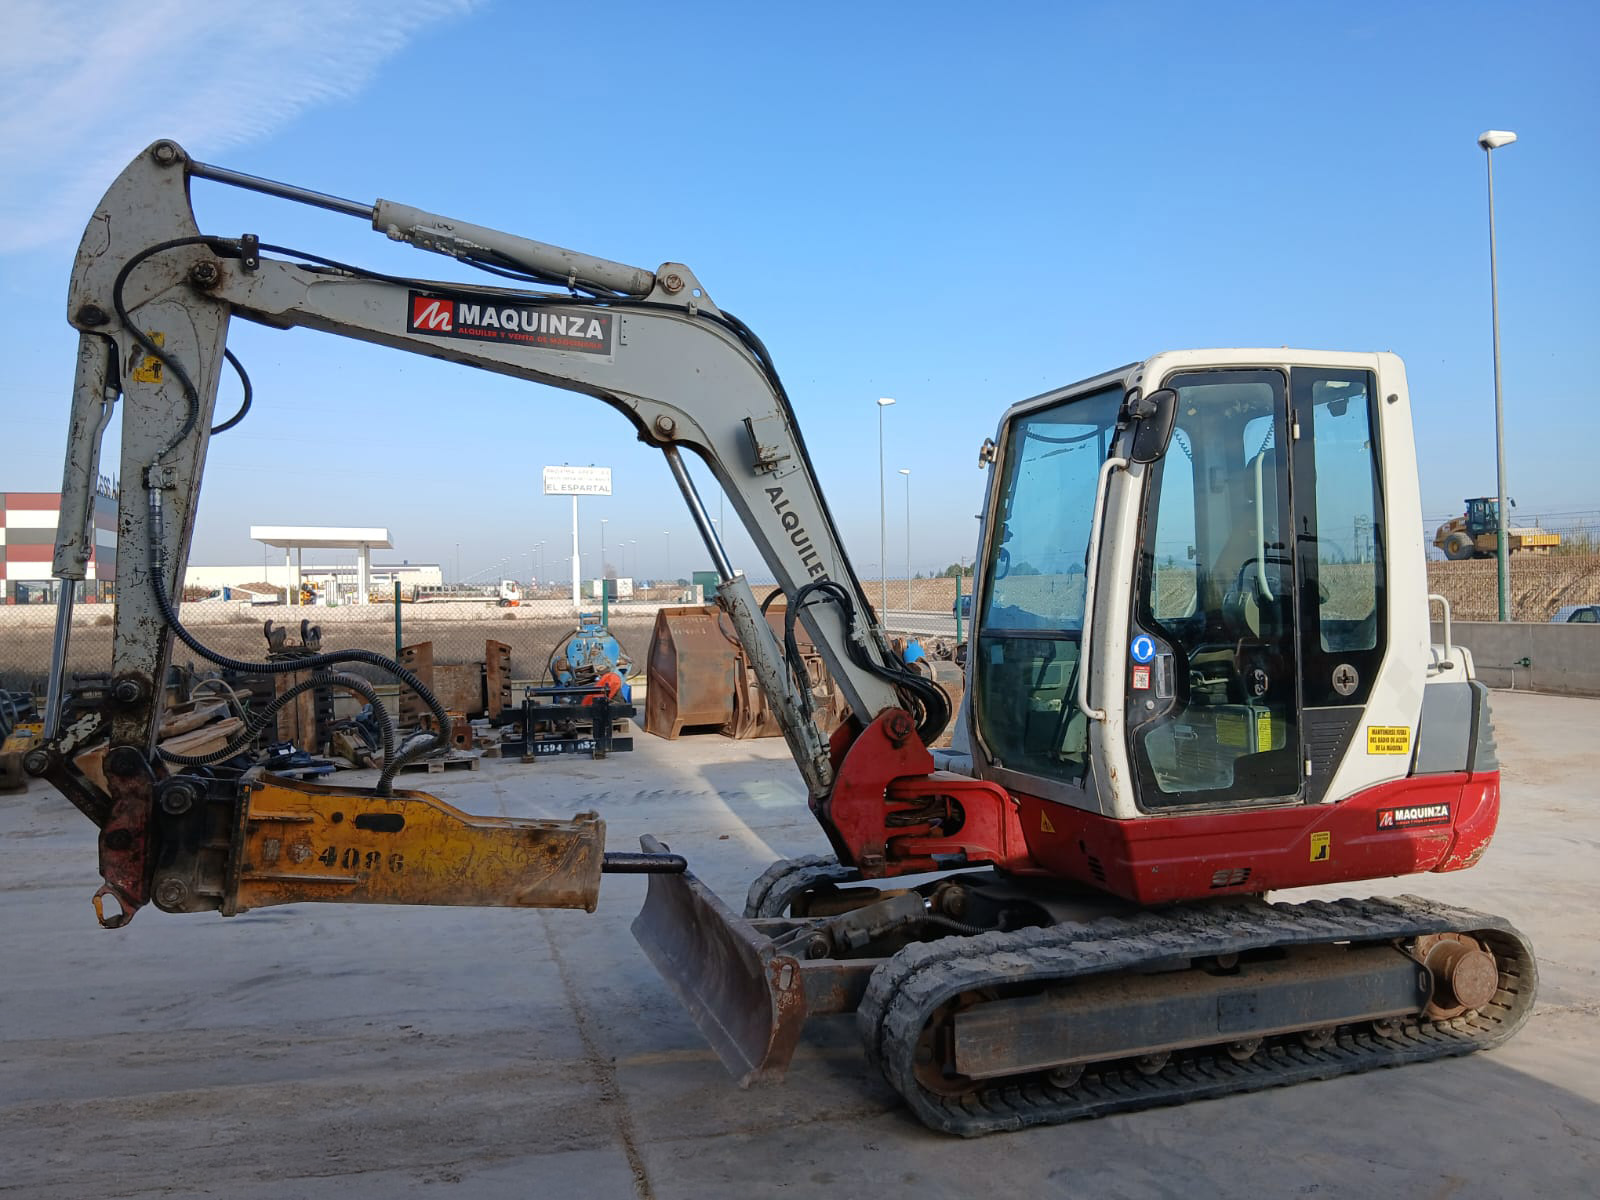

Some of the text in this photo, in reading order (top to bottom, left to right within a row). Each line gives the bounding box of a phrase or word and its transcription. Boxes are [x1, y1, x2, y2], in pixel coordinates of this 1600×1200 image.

[458, 303, 604, 339] MAQUINZA
[458, 327, 497, 338] ALQUILER
[508, 332, 535, 342] VENTA
[546, 483, 610, 492] EL ESPARTAL
[1395, 805, 1449, 821] MAQUINZA
